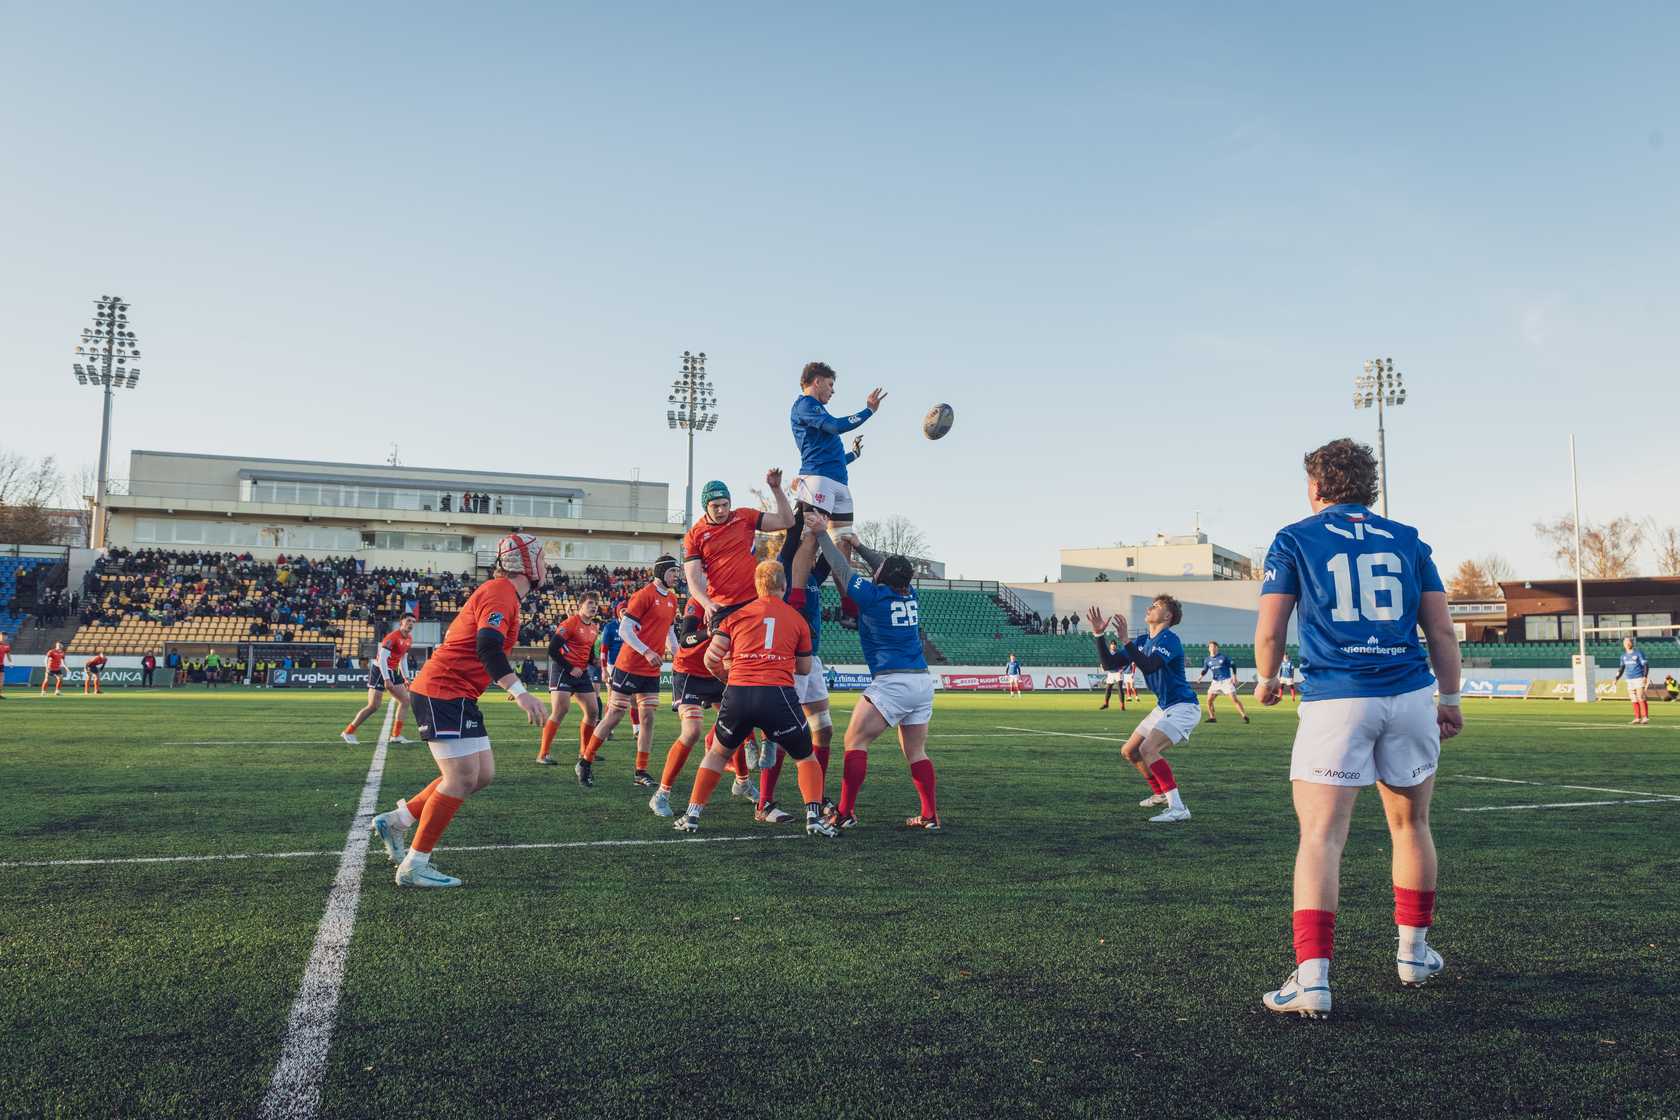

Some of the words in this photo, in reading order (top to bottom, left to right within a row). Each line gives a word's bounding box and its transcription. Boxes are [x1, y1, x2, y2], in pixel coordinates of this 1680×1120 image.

[1327, 552, 1404, 622] 16
[763, 617, 776, 650] 1
[91, 671, 142, 681] ANKA
[291, 673, 335, 684] rugby
[337, 674, 370, 683] euro
[1045, 675, 1079, 689] AON
